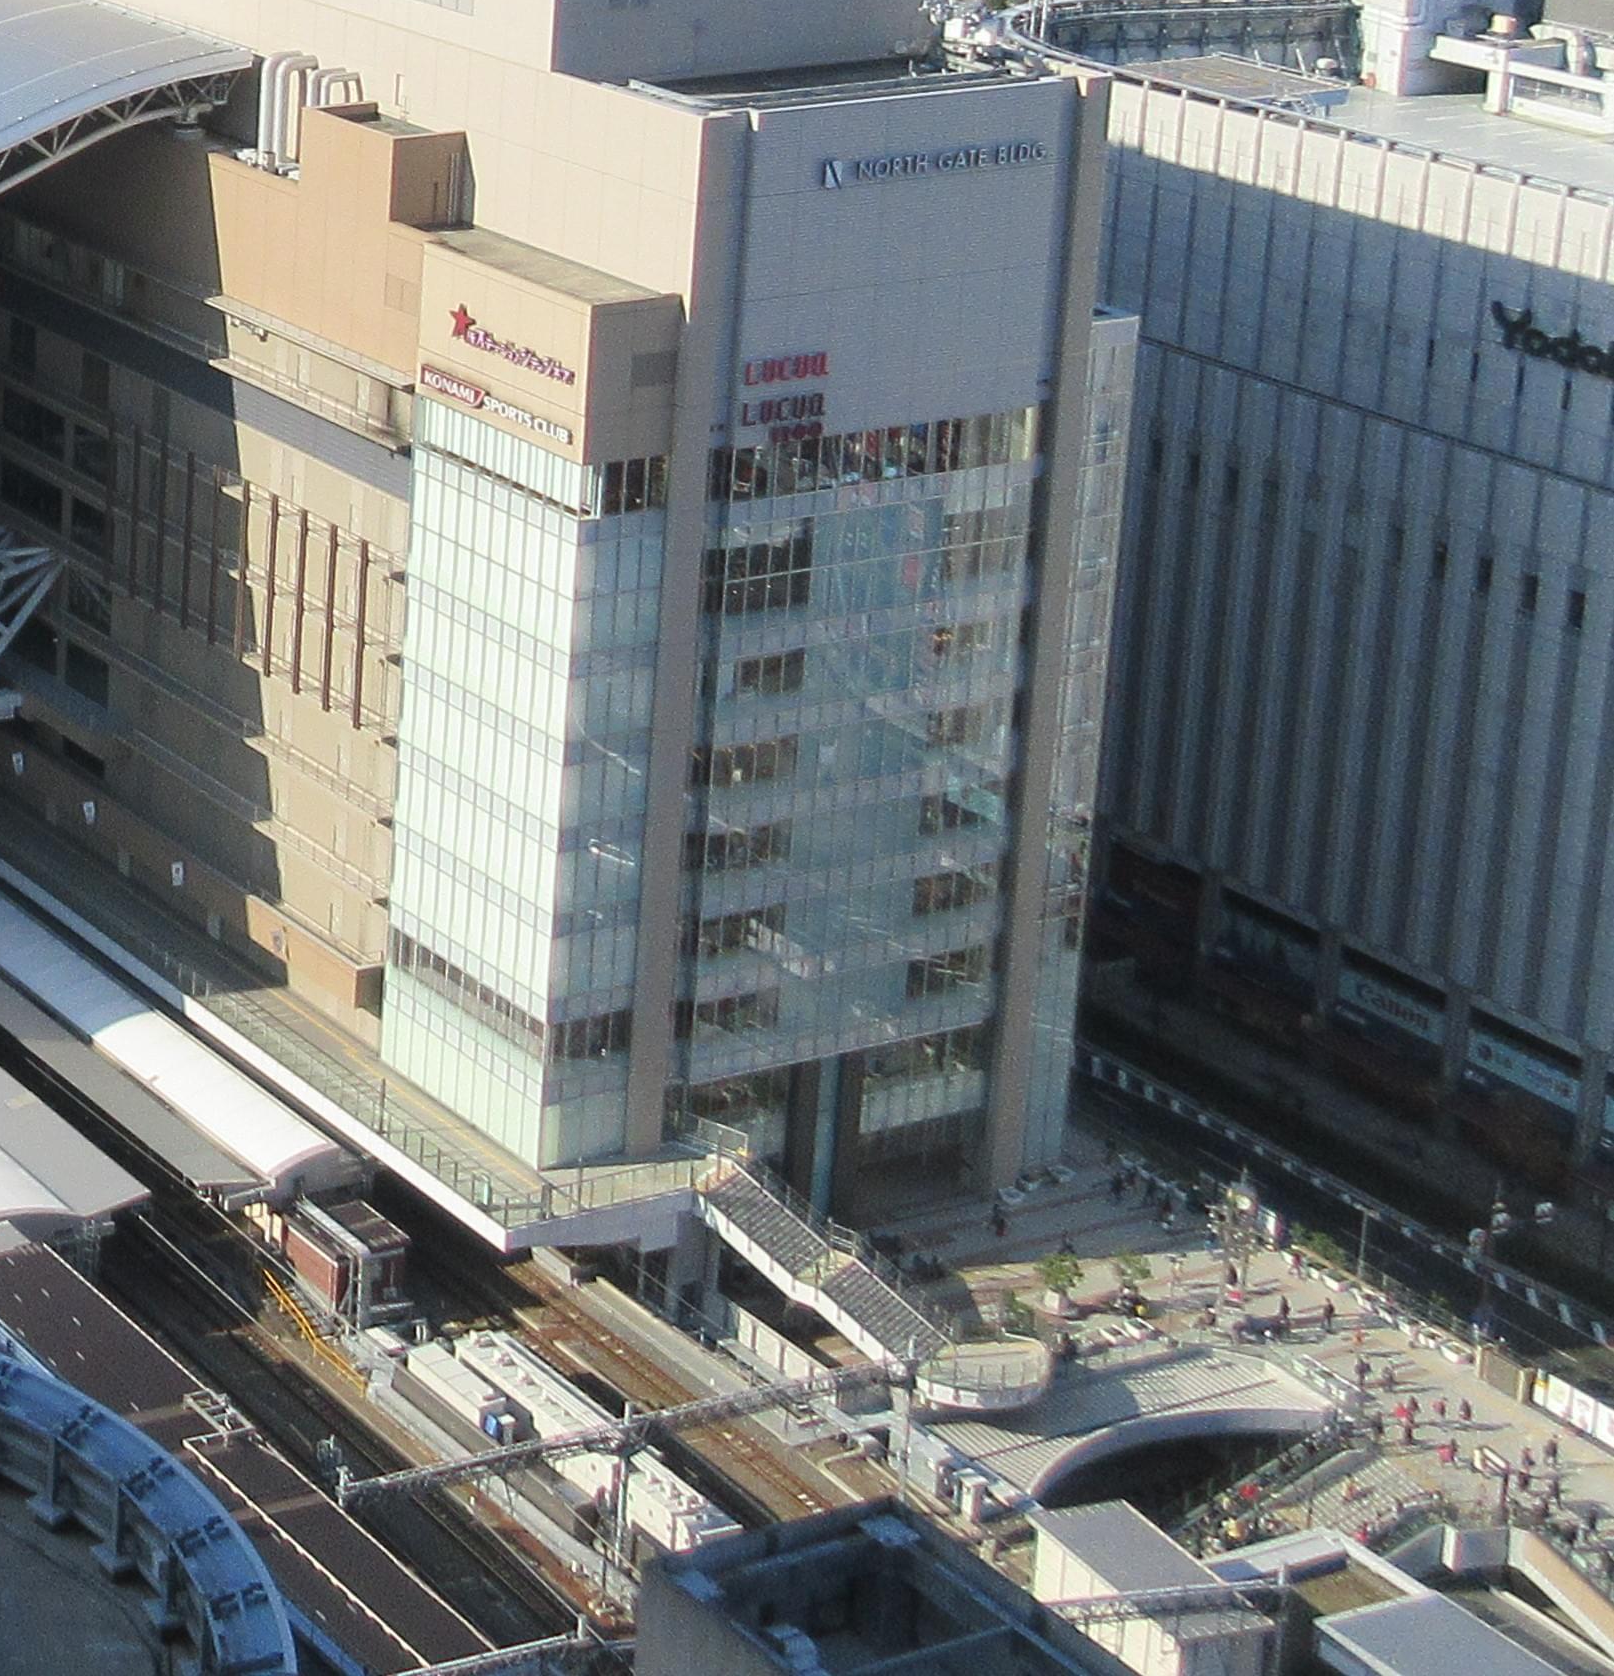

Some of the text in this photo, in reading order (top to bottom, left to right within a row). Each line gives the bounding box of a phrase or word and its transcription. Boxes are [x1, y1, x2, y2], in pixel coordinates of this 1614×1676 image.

[856, 155, 930, 180] NORTH
[938, 148, 989, 172] GATE
[1491, 300, 1614, 378] Yodo
[423, 370, 571, 443] KONAMI SPORTS CLUB
[741, 393, 826, 426] LUCUA
[1356, 984, 1430, 1031] Canon
